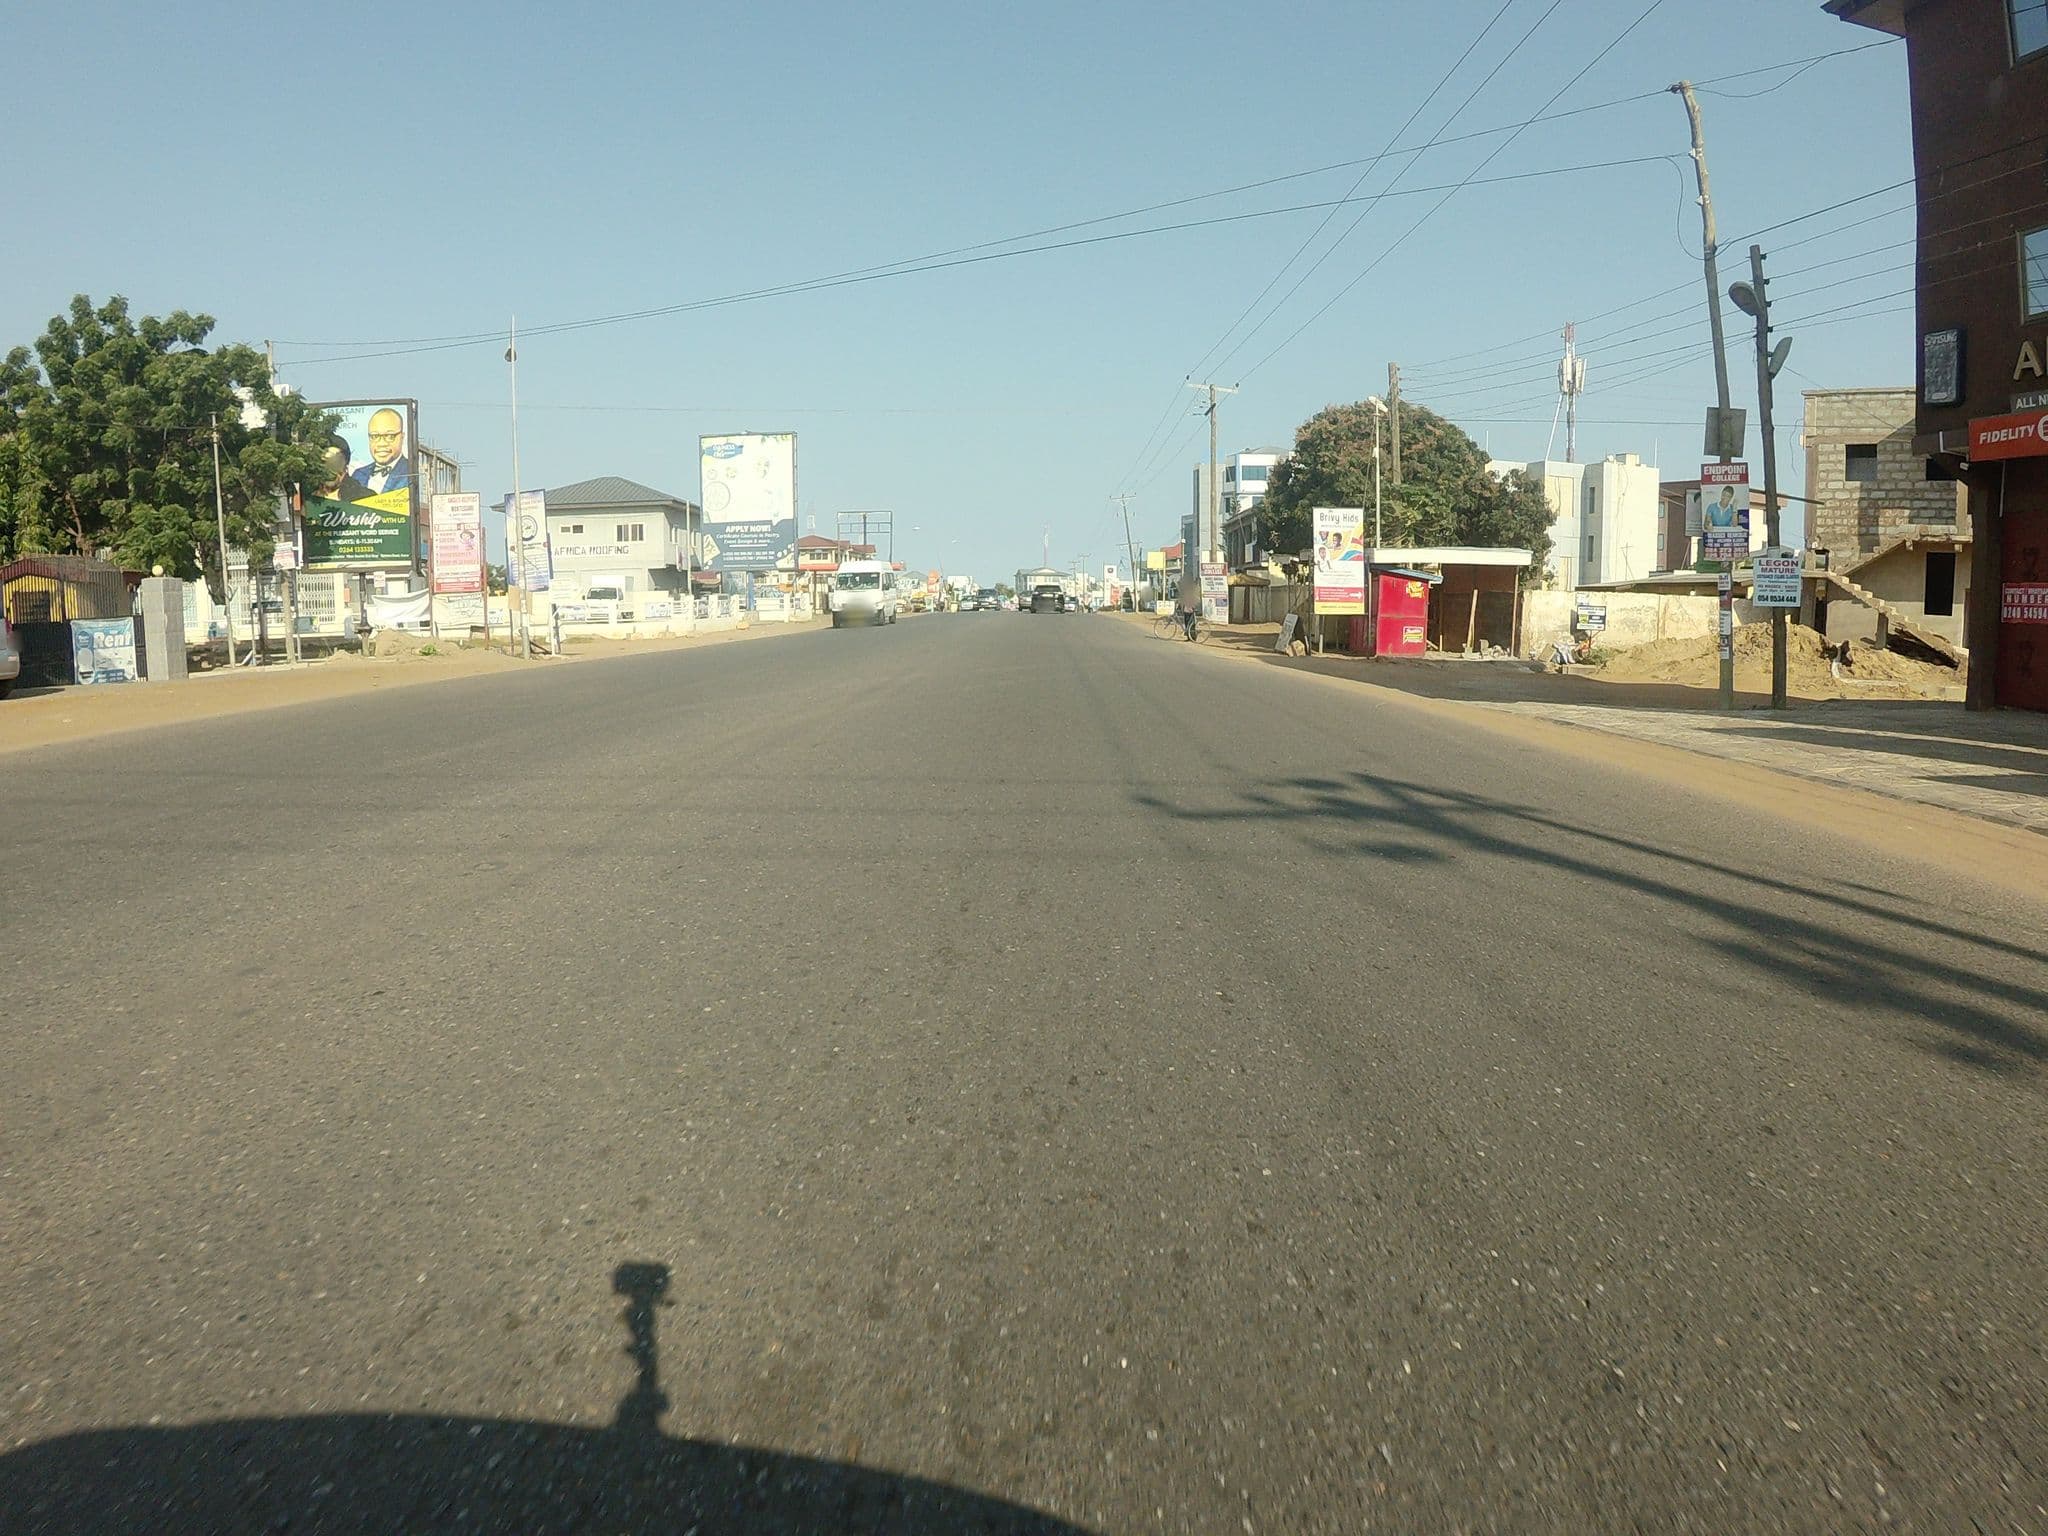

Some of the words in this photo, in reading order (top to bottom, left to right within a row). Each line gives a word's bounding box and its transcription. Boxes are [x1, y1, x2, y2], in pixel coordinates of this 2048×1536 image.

[2016, 397, 2037, 409] ALL
[1979, 424, 2036, 445] FIDELITY
[1703, 465, 1747, 475] ENDPOINT
[1711, 474, 1741, 482] COLLEGE
[319, 511, 382, 528] Worship
[749, 524, 772, 532] NOW!
[554, 546, 587, 556] AFRICA
[589, 545, 630, 555] ROOFING
[93, 631, 132, 649] Rent
